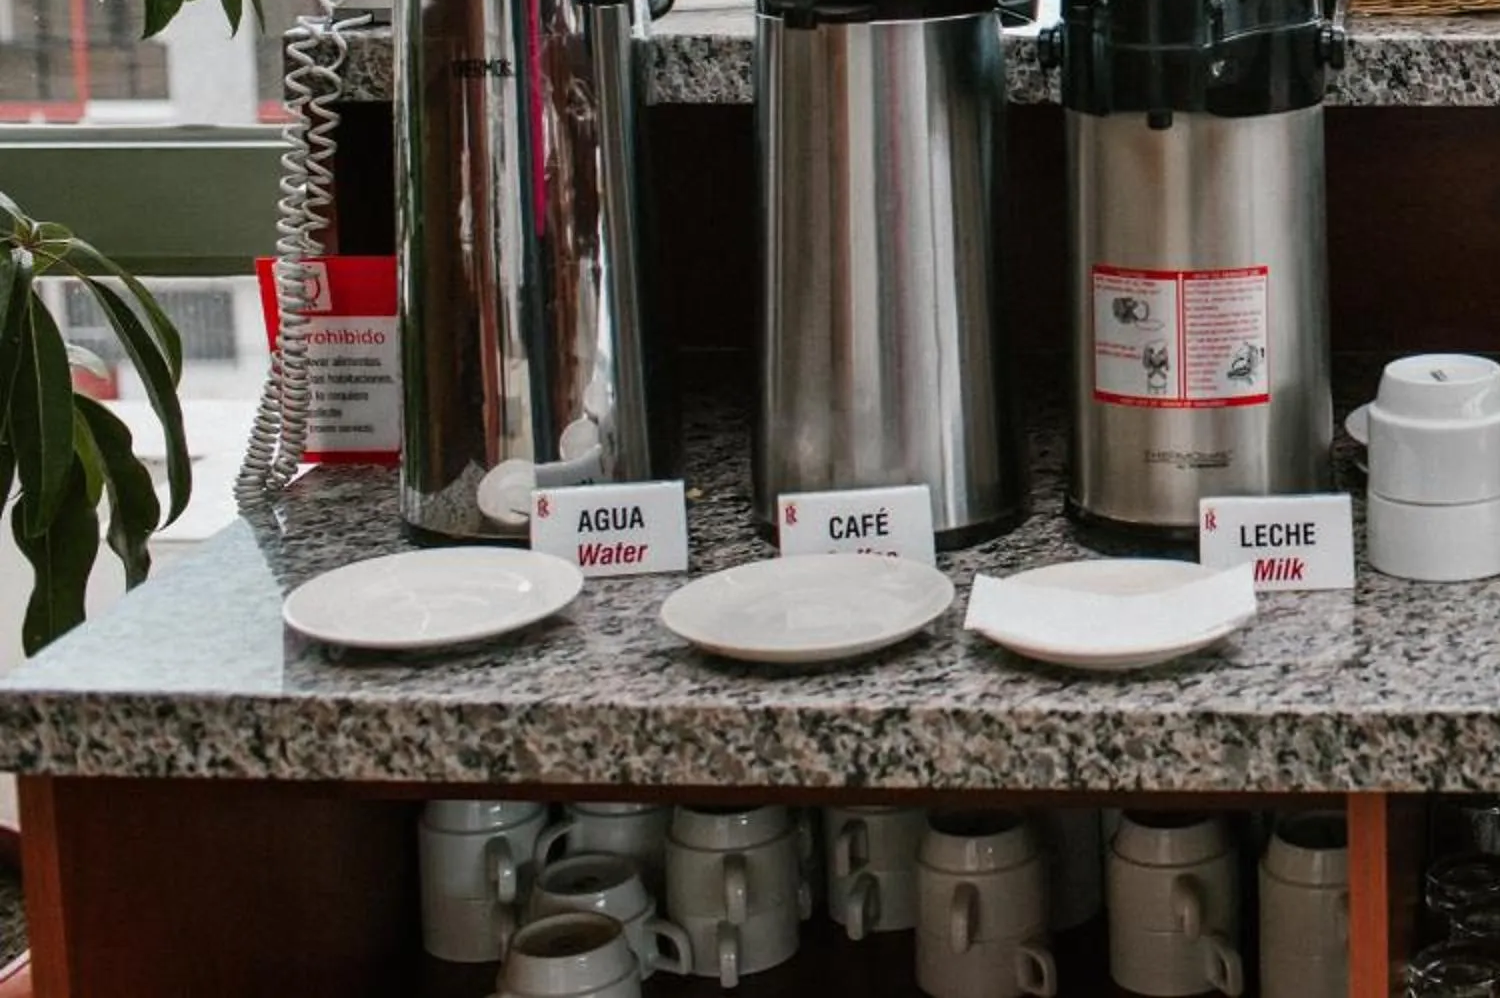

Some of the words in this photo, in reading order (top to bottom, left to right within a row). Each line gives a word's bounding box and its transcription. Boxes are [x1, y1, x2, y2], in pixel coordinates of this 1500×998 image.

[303, 329, 385, 344] rohibido
[577, 506, 645, 532] AGUA
[829, 508, 889, 539] CAFÉ
[1240, 522, 1316, 547] LECHE
[578, 541, 648, 567] Water
[1254, 557, 1305, 582] Milk
